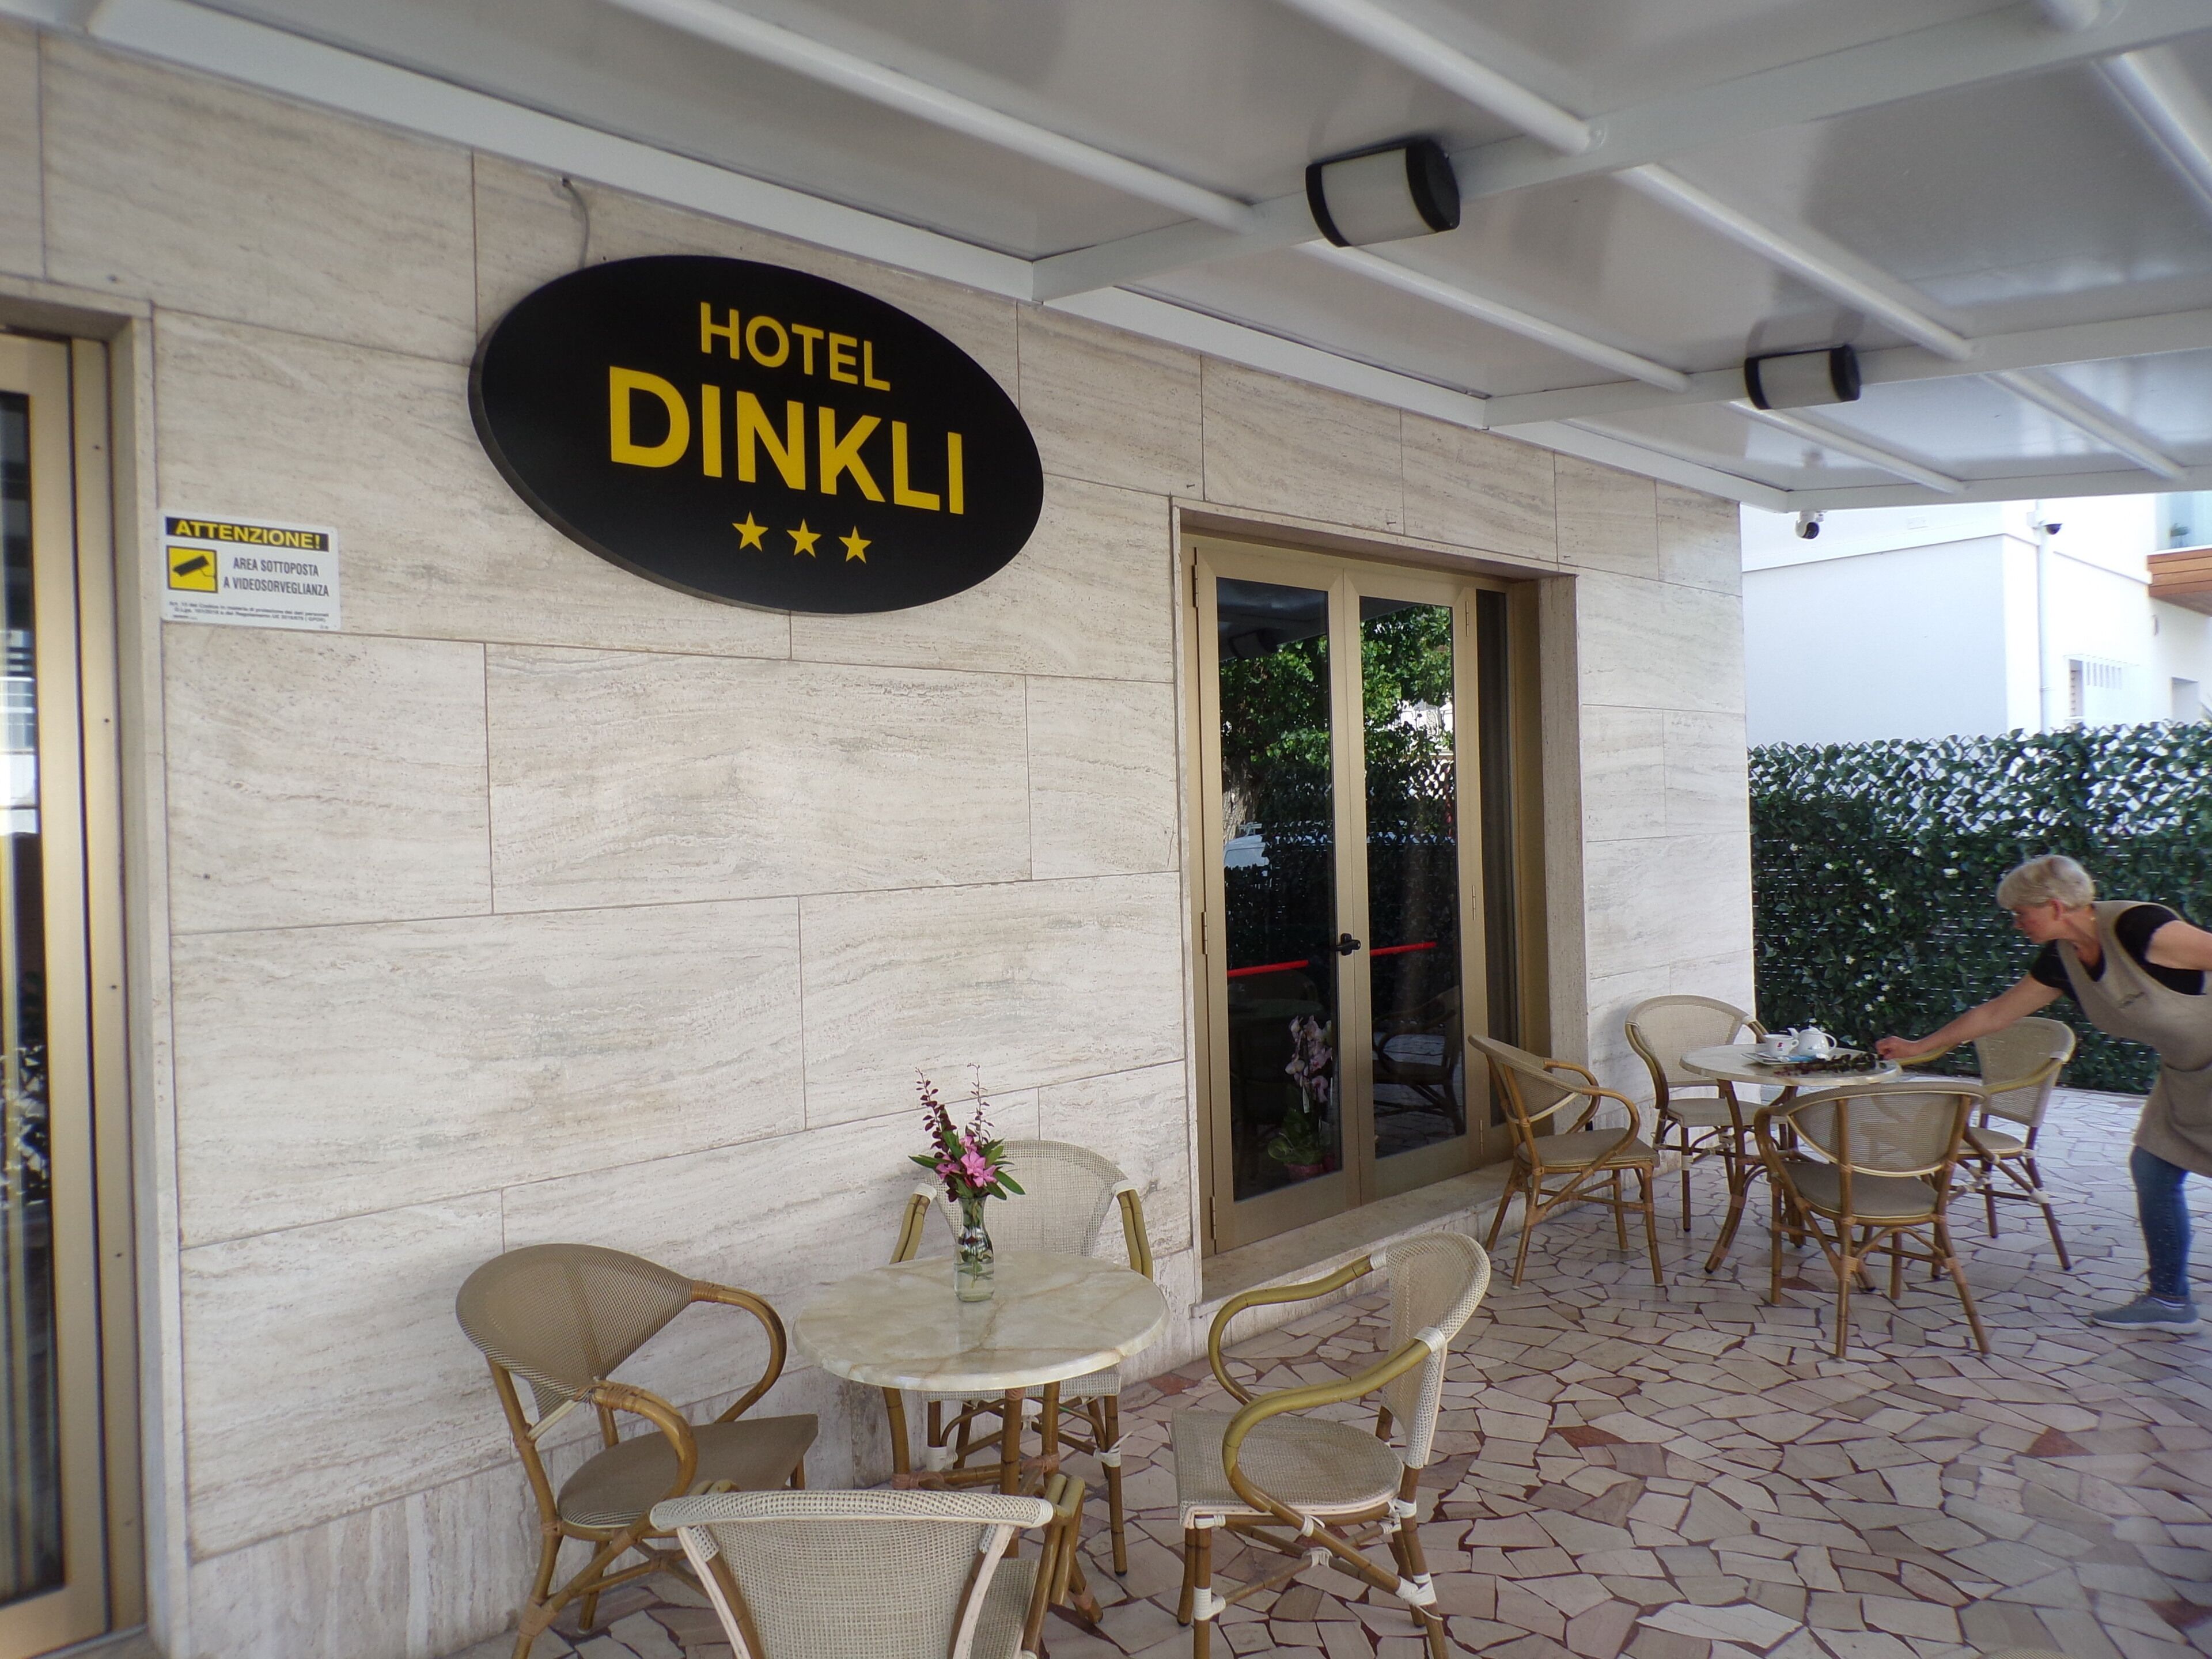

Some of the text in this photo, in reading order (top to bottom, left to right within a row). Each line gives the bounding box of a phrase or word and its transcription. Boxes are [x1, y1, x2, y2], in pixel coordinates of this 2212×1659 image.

[700, 302, 891, 391] HOTEL
[609, 366, 964, 515] DINKLI
[175, 520, 320, 549] ATTENZIONE!
[233, 557, 319, 577] AREA SOTTOPOSTA
[224, 576, 329, 596] A VIDEOSORVEGLIANZA
